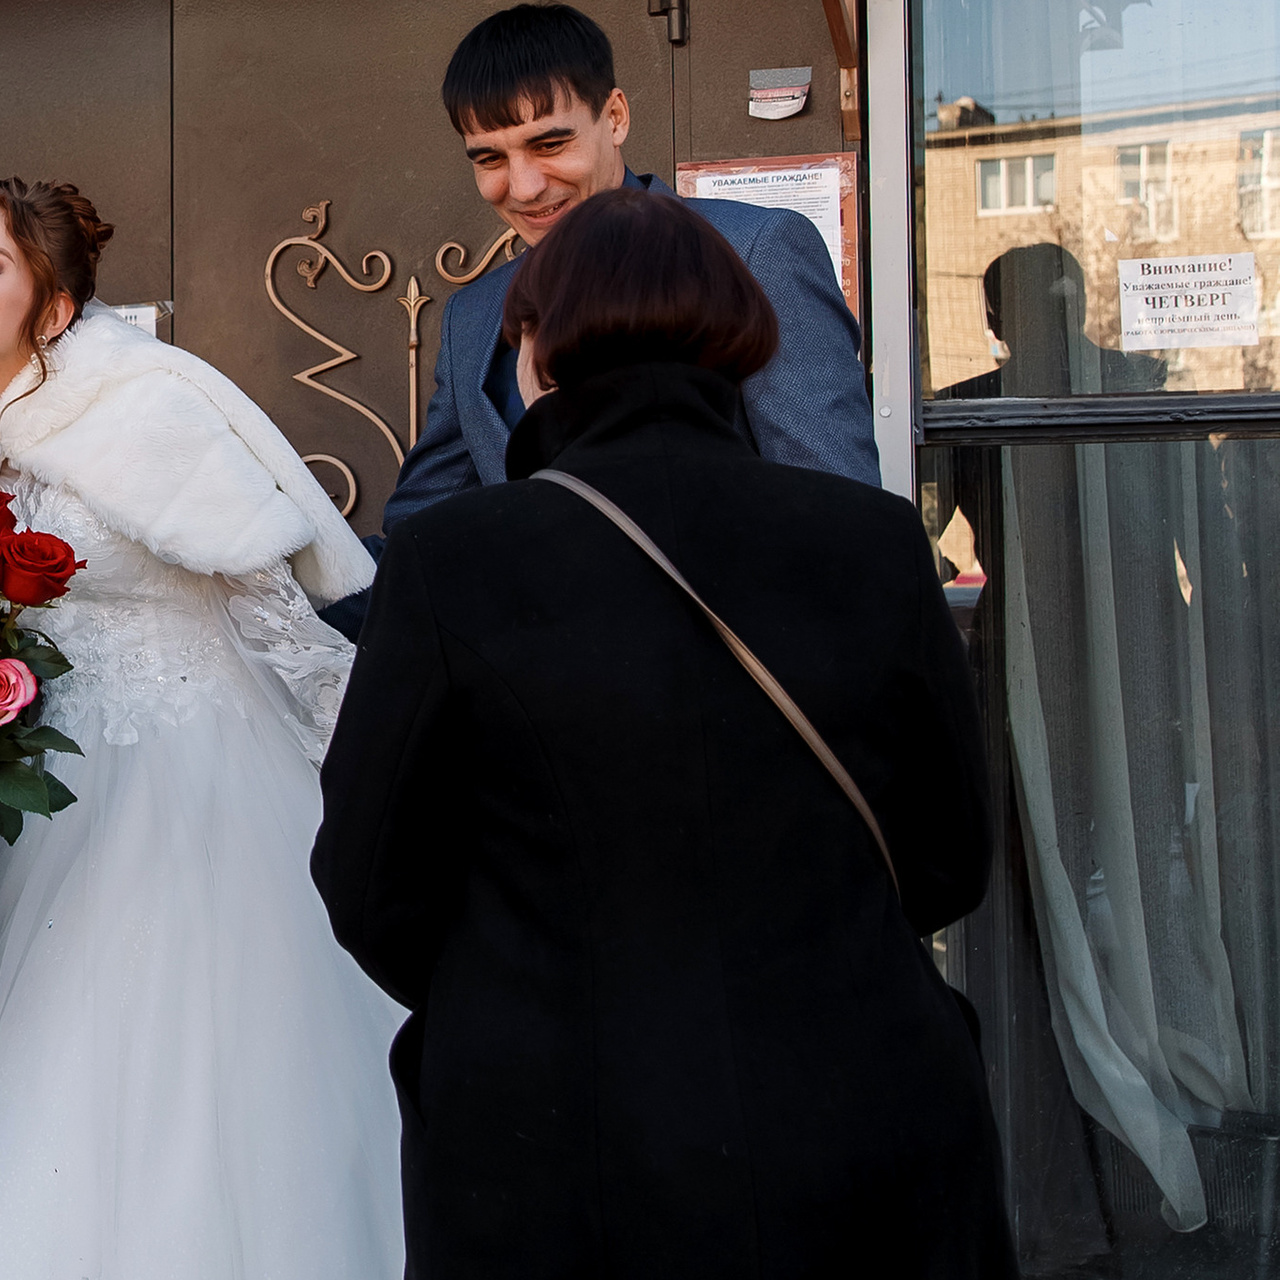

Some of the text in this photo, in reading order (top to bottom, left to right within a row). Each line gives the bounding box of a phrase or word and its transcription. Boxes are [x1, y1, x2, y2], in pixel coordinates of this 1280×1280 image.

[711, 173, 823, 187] УВАЖАЕМЫЕ ГРАЖДАНЕ!
[1140, 258, 1232, 276] Внимание!
[1123, 276, 1252, 292] Уважаемые граждане!
[1144, 291, 1232, 309] ЧЕТВЕРГ
[1213, 313, 1241, 323] день
